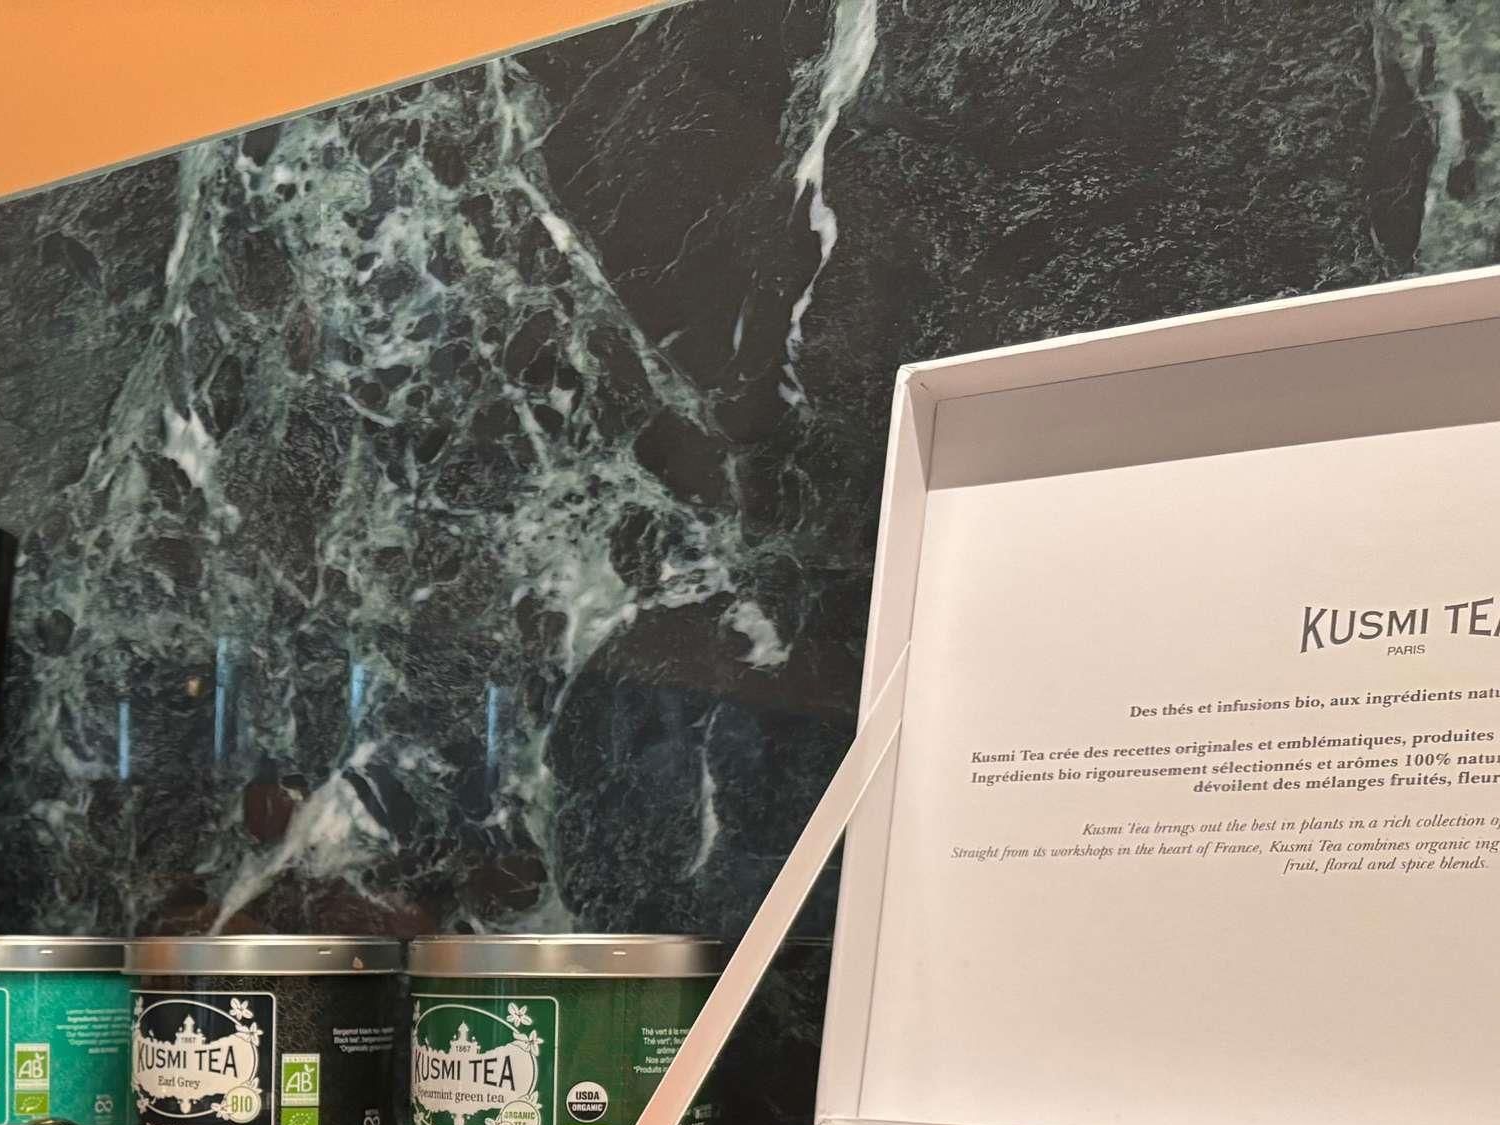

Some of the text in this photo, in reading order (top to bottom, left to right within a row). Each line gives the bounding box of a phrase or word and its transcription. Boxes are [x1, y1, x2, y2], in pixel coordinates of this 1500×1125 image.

[1300, 606, 1428, 654] KUSMI
[1387, 644, 1426, 656] PARIS
[1130, 705, 1157, 718] Des
[1162, 703, 1193, 716] thés
[1198, 703, 1212, 714] et
[1217, 700, 1290, 714] infusions
[1295, 696, 1325, 710] bio,
[1330, 696, 1360, 707] aux
[1367, 688, 1462, 708] ingrédients
[971, 730, 1494, 763] Kusmi Tea crée des recettes originales et emblématiques, produites
[971, 769, 1054, 787] Ingrédients
[1058, 769, 1081, 781] bio
[1086, 763, 1207, 783] rigoureusement
[1211, 759, 1312, 775] sélectionnés
[1317, 758, 1333, 770] et
[1337, 755, 1399, 769] arômes
[1404, 753, 1451, 767] 100%
[1193, 771, 1500, 793] dévoilent des mélanges fruités, fleur
[1082, 823, 1123, 836] Kusmi
[1128, 822, 1149, 835] Tea
[1153, 821, 1196, 837] brings
[1200, 821, 1222, 833] out
[1226, 819, 1247, 832] the
[1251, 819, 1277, 832] best
[1281, 819, 1295, 831] in
[1298, 817, 1344, 834] plants
[1350, 818, 1364, 830] in
[1369, 819, 1378, 829] a
[1383, 815, 1411, 829] rich
[1415, 814, 1486, 828] collection
[951, 846, 998, 861] Straight
[1000, 846, 1030, 862] from
[1033, 845, 1047, 857] its
[1051, 843, 1114, 860] workshops
[1118, 843, 1131, 855] in
[1135, 842, 1155, 855] the
[1158, 841, 1192, 855] heart
[1197, 840, 1213, 858] of
[1214, 841, 1263, 856] France,
[1269, 840, 1313, 853] Kusmi
[1319, 839, 1342, 852] Tea
[1347, 838, 1410, 852] combines
[1415, 837, 1472, 854] organic
[1283, 856, 1488, 875] fruit, floral and spice blends.
[137, 1040, 237, 1078] KUSMI TEA
[415, 1048, 515, 1091] KUSMI TEA
[158, 1075, 201, 1090] Earl Grey
[231, 1095, 252, 1113] BIO
[454, 1091, 484, 1104] green
[487, 1092, 505, 1104] tea
[575, 1091, 600, 1100] USDA
[503, 1111, 535, 1120] ORGANIC
[571, 1103, 603, 1112] ORGANIC
